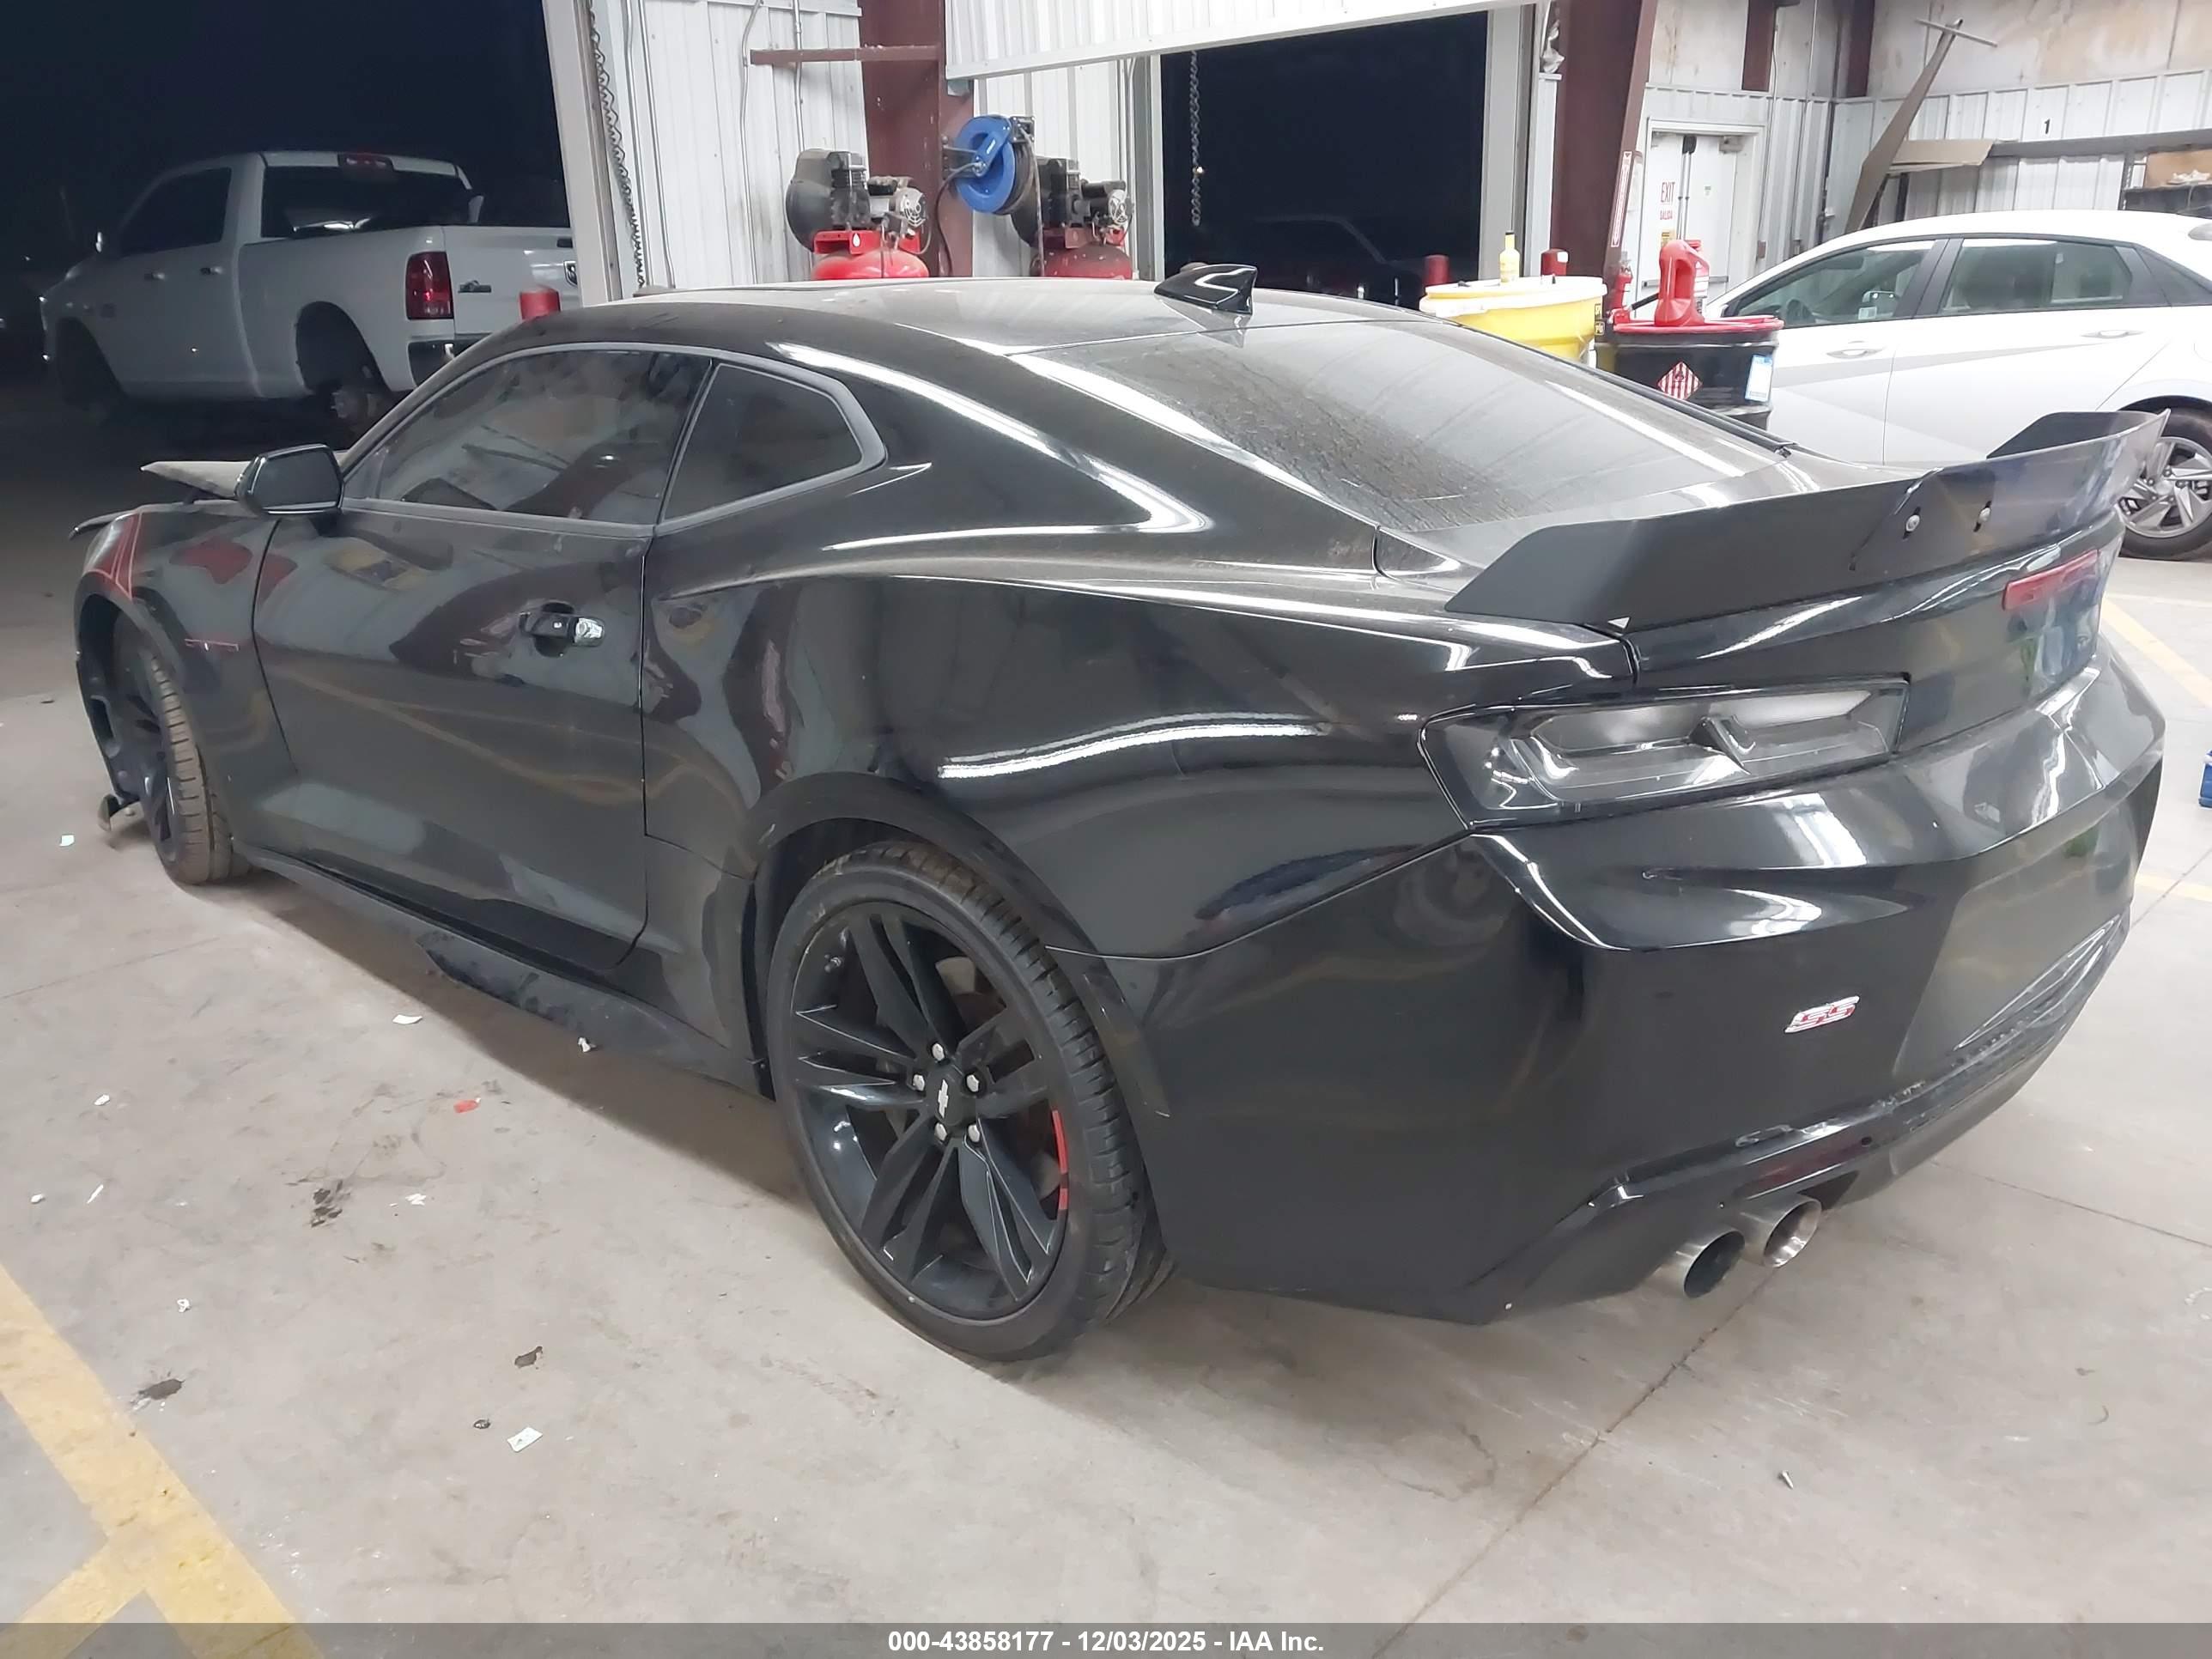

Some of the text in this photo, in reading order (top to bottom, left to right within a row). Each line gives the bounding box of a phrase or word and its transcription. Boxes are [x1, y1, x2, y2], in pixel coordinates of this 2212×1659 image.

[2044, 118, 2051, 135] 1
[1660, 181, 1675, 203] EXIT
[1784, 995, 1860, 1034] SS
